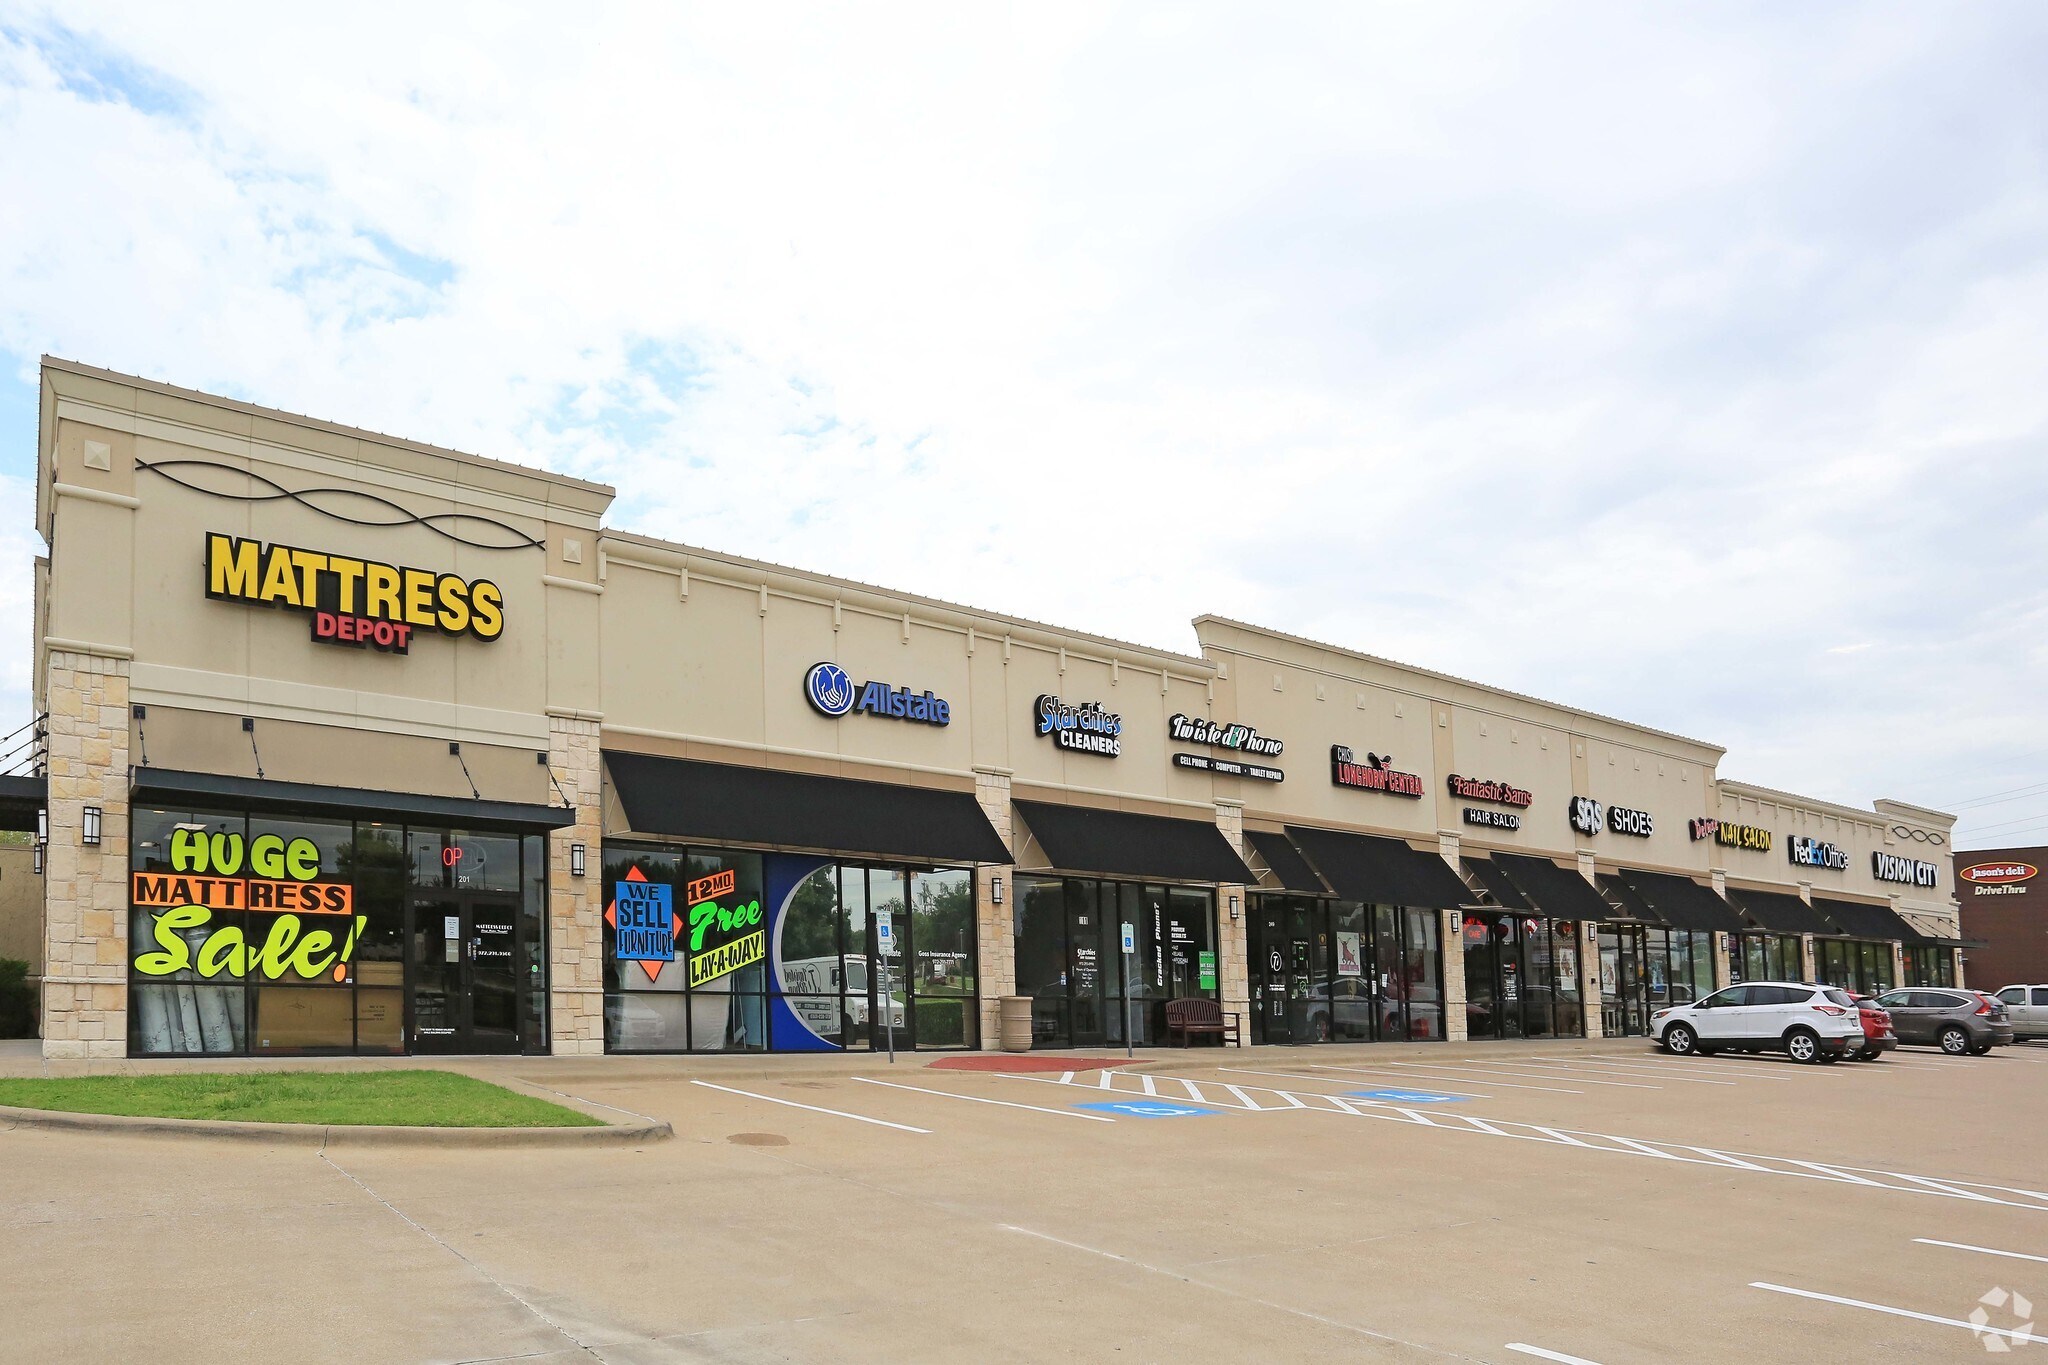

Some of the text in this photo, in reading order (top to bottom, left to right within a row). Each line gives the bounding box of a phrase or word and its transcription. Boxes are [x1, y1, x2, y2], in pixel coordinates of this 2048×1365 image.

[209, 534, 503, 637] MATTRESS
[316, 611, 411, 648] DEPOT
[856, 681, 950, 724] Allstate
[1041, 695, 1122, 736] Starchies
[1060, 730, 1121, 755] CLEANERS
[1180, 756, 1282, 780] CELL PHONE COMPUTER TABLET REPAIR
[1338, 763, 1425, 795] LONGHORN CENTRAL
[1454, 776, 1533, 806] Fantastic Sams
[1470, 810, 1521, 828] HAIR SALON
[1576, 798, 1654, 836] SAS SHOES
[1720, 822, 1742, 846] NAIL
[1743, 827, 1771, 849] SALON
[458, 875, 470, 883] 201
[1877, 853, 1939, 887] VISION CITY
[1971, 866, 2025, 880] Jason's deli
[136, 876, 346, 912] MATTRESS
[627, 884, 659, 900] WE
[619, 898, 668, 928] SELL
[689, 900, 763, 952] Free
[134, 904, 367, 983] Sale!
[618, 928, 673, 957] FURNITURE
